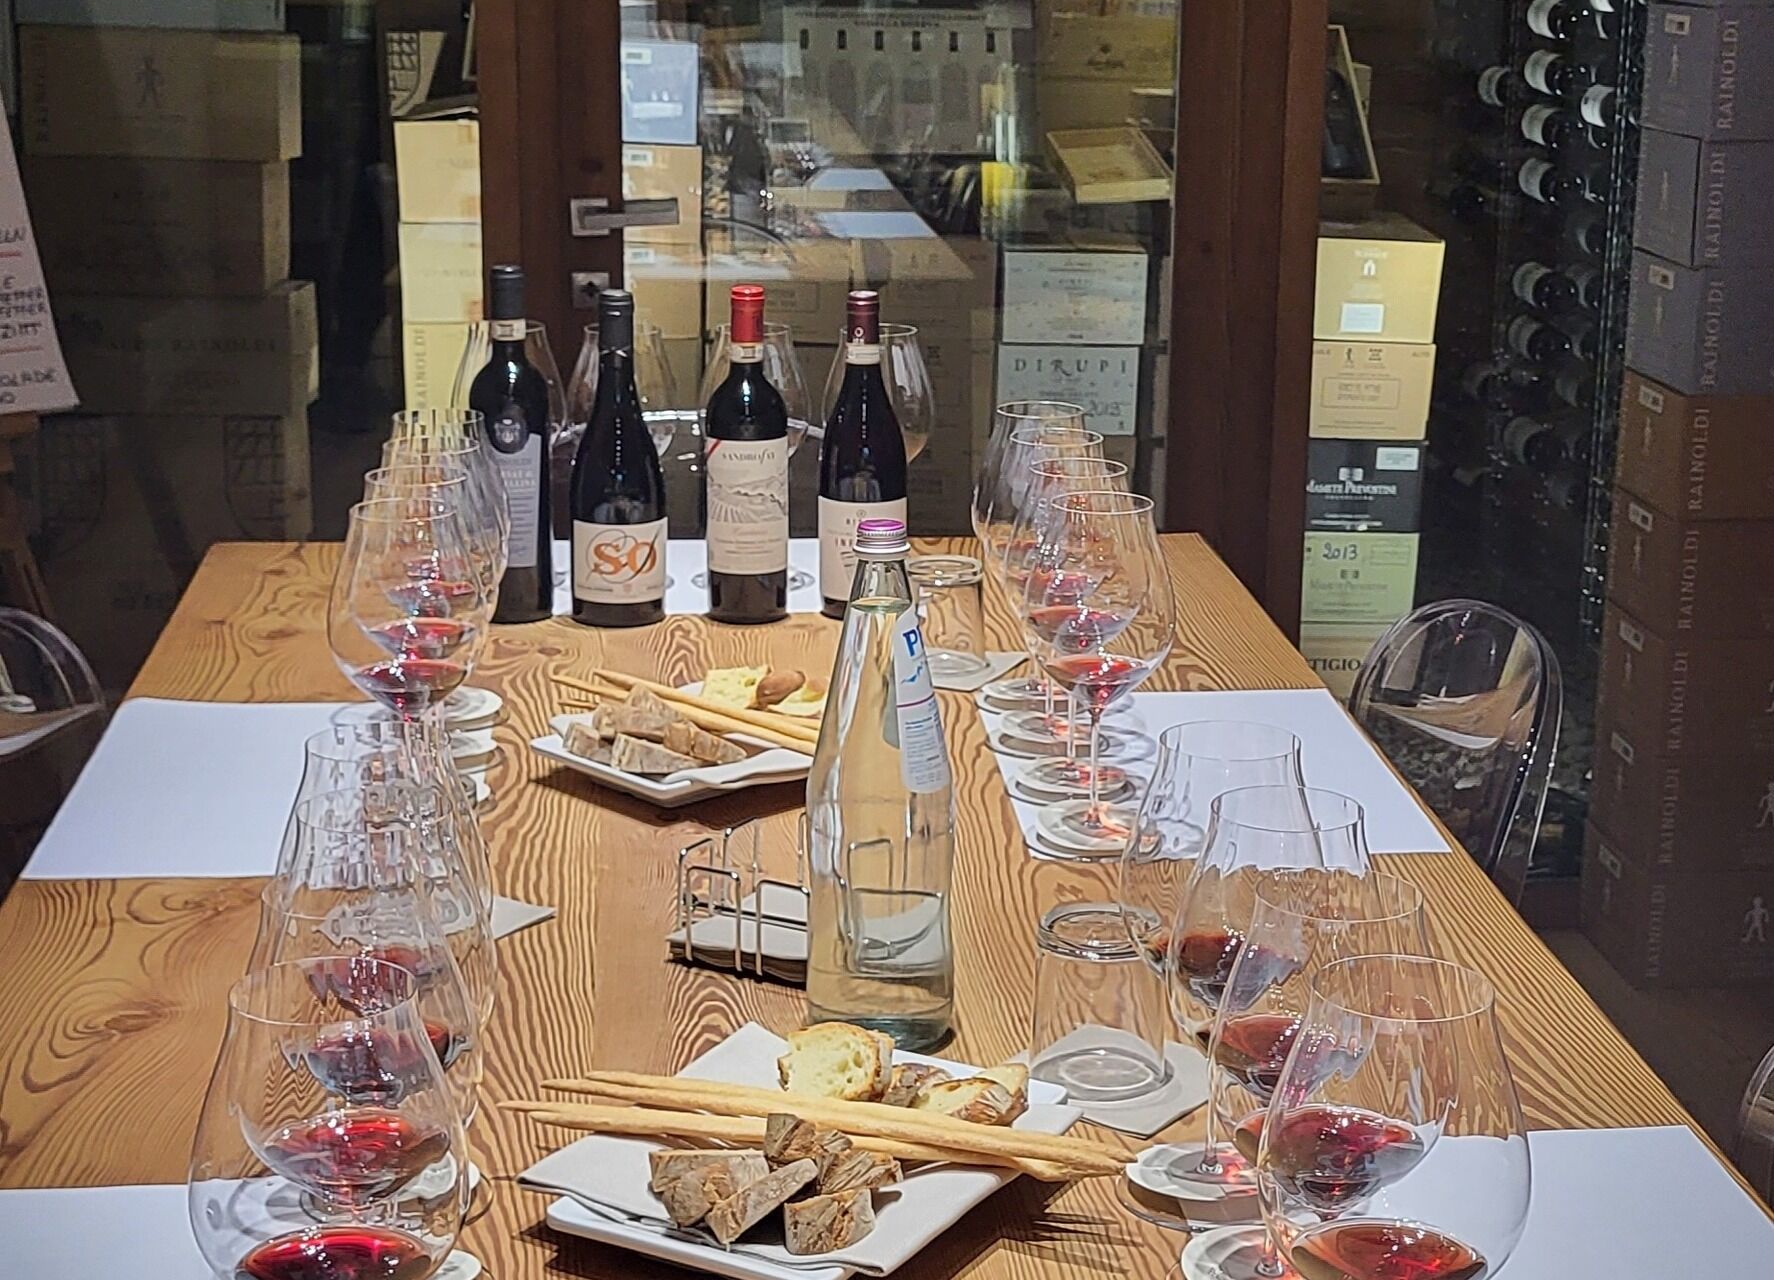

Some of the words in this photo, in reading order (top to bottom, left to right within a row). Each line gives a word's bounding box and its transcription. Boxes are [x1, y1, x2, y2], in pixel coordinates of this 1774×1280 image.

[1717, 19, 1740, 131] RAINOLDI
[1705, 151, 1726, 260] RAINOLDI
[1014, 358, 1127, 376] DIRUPI
[1700, 280, 1725, 386] RAINOLDI
[1688, 408, 1711, 512] RAINOLDI
[1322, 542, 1358, 561] 2013
[1678, 529, 1700, 630] RAINOLDI
[1308, 658, 1362, 672] TIGIO
[1666, 650, 1689, 751] RAINOLDI
[1657, 767, 1681, 865] RAINOLDI
